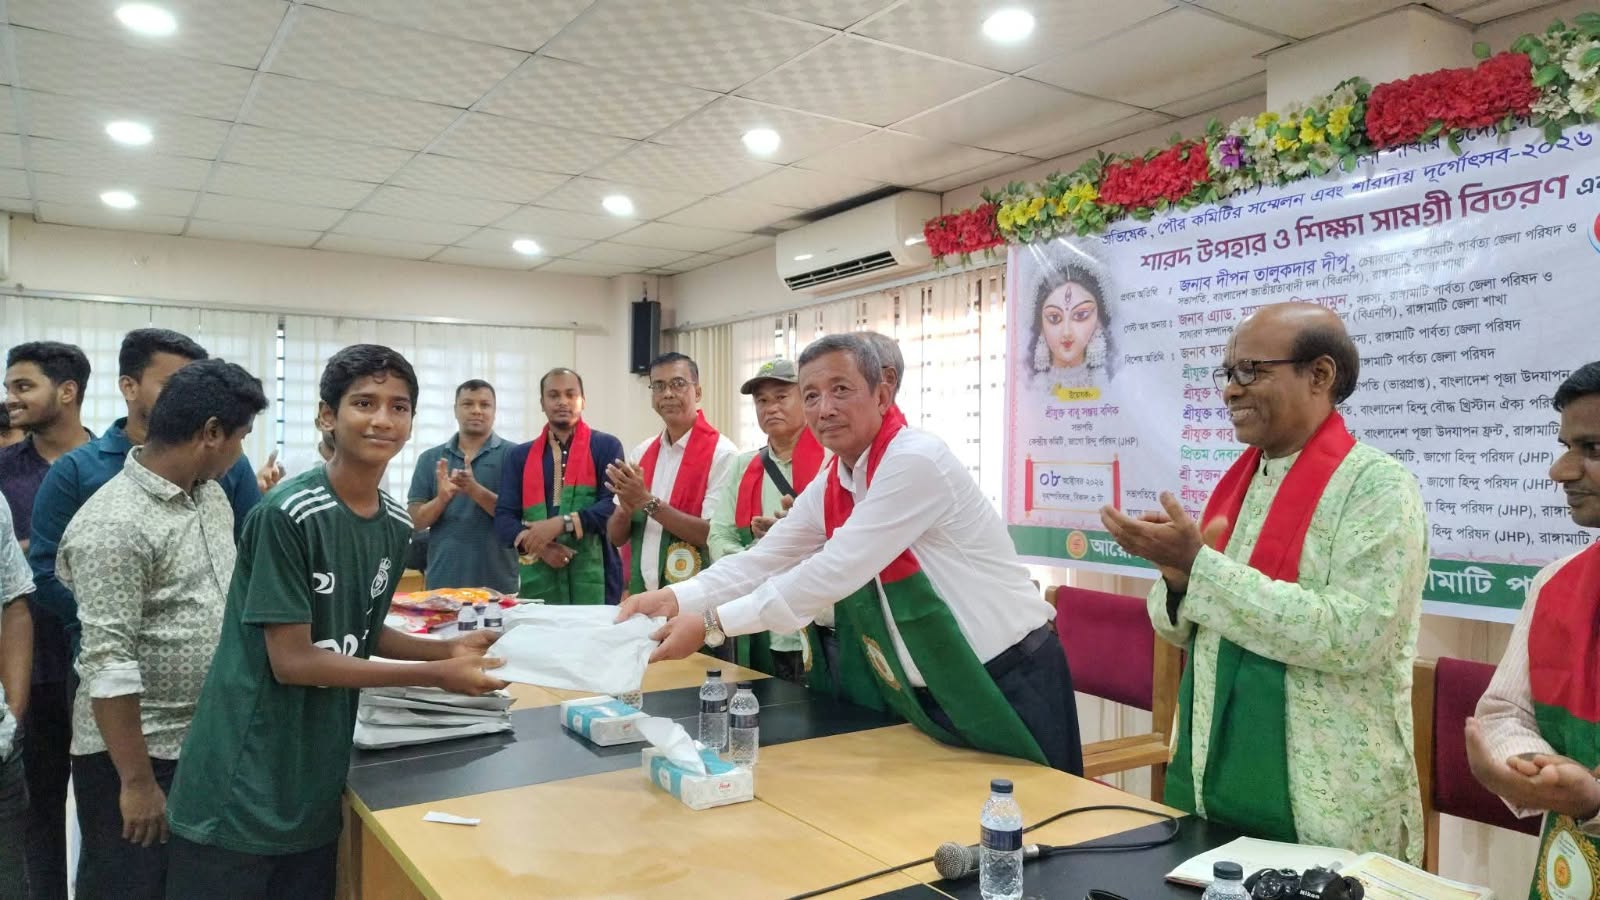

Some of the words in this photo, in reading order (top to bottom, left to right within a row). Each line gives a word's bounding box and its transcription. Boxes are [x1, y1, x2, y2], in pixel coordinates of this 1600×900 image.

[1158, 218, 1186, 235] পৌর
[1191, 205, 1243, 226] কমিটির
[1248, 193, 1305, 214] সম্মেলন
[1311, 186, 1344, 201] এবং
[1352, 167, 1416, 192] শারদীয়
[1141, 247, 1193, 271] শারদ
[1197, 232, 1267, 262] উপহার
[1273, 229, 1291, 249] ও
[1295, 214, 1364, 246] শিক্ষা
[1369, 190, 1452, 227] সামগ্রী
[1458, 174, 1569, 218] বিতরণ
[1179, 275, 1213, 293] জনাব
[1216, 268, 1250, 287] দীপন
[1254, 259, 1317, 283] তালুকদার
[1494, 231, 1521, 247] জেলা
[1525, 224, 1563, 241] পরিষদ
[1567, 223, 1577, 234] ও
[1178, 312, 1204, 327] জনাব
[1433, 280, 1466, 297] পার্বত্য
[1469, 277, 1496, 292] জেলা
[1501, 272, 1538, 288] পরিষদ
[1543, 271, 1553, 282] ও
[1213, 287, 1249, 303] বাংলাদেশ
[1306, 277, 1319, 289] দল
[1406, 297, 1448, 317] রাঙ্গামাটি
[1452, 296, 1479, 311] জেলা
[1482, 293, 1508, 307] শাখা
[1180, 347, 1206, 360] জনাব
[1375, 326, 1415, 342] রাঙ্গামাটি
[1419, 323, 1450, 338] পার্বত্য
[1454, 323, 1481, 336] জেলা
[1485, 318, 1521, 333] পরিষদ
[1397, 351, 1428, 366] পার্বত্য
[1431, 350, 1457, 363] জেলা
[1460, 346, 1496, 360] পরিষদ
[1439, 374, 1489, 388] বাংলাদেশ
[1494, 373, 1516, 387] পূজা
[1521, 369, 1570, 383] উদযাপন
[1183, 404, 1212, 422] শ্রীযুক্ত
[1360, 404, 1403, 416] বাংলাদেশ
[1407, 400, 1428, 416] হিন্দু
[1431, 400, 1456, 414] বৌদ্ধ
[1500, 395, 1525, 411] ঐক্য
[1118, 437, 1139, 448] (JHP)
[1181, 425, 1211, 442] শ্রীযুক্ত
[1216, 428, 1234, 444] বাবু
[1365, 427, 1407, 440] বাংলাদেশ
[1412, 427, 1431, 440] পূজা
[1435, 424, 1479, 438] উদযাপন
[1513, 421, 1560, 437] রাঙ্গামাটি
[1180, 445, 1209, 461] প্রিতম
[1423, 451, 1452, 463] জাগো
[1455, 449, 1476, 464] হিন্দু
[1480, 448, 1515, 463] পরিষদ
[1518, 452, 1554, 465] (JHP)
[1040, 470, 1061, 487] ০৮
[1179, 465, 1192, 480] শ্রী
[1426, 477, 1455, 489] জাগো
[1458, 474, 1480, 490] হিন্দু
[1484, 475, 1520, 490] পরিষদ
[1522, 479, 1558, 493] (JHP)
[1436, 499, 1456, 515] হিন্দু
[1460, 500, 1494, 516] পরিষদ
[1497, 505, 1537, 519] (JHP),
[1432, 524, 1452, 541] হিন্দু
[1456, 525, 1491, 541] পরিষদ
[1494, 532, 1535, 545] (JHP),
[1539, 531, 1591, 546] রাঙ্গামাটি
[1300, 889, 1320, 899] Nikon
